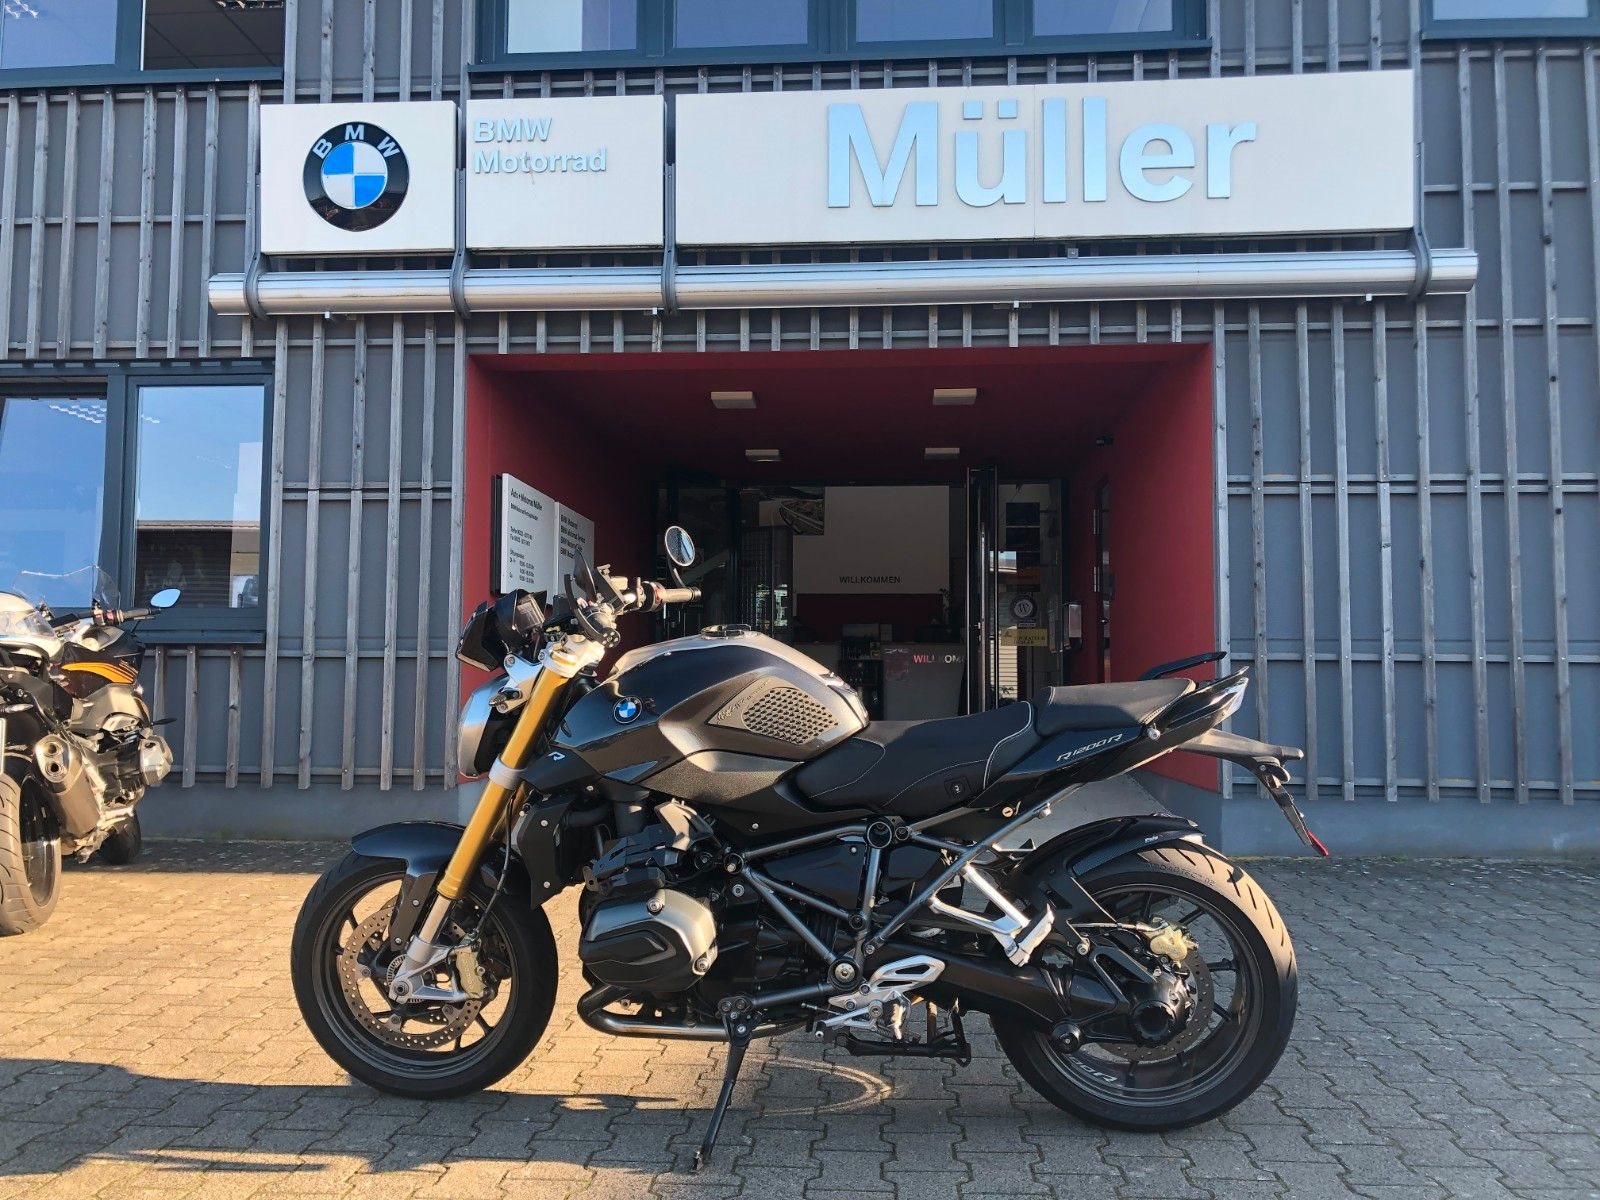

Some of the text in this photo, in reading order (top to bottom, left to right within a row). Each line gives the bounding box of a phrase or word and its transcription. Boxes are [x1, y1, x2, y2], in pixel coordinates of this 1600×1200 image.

[312, 123, 400, 160] BMW
[474, 116, 553, 144] BMW
[474, 147, 607, 175] Motorrad
[827, 96, 1257, 209] Müller
[839, 575, 901, 585] WILLKOMMEN
